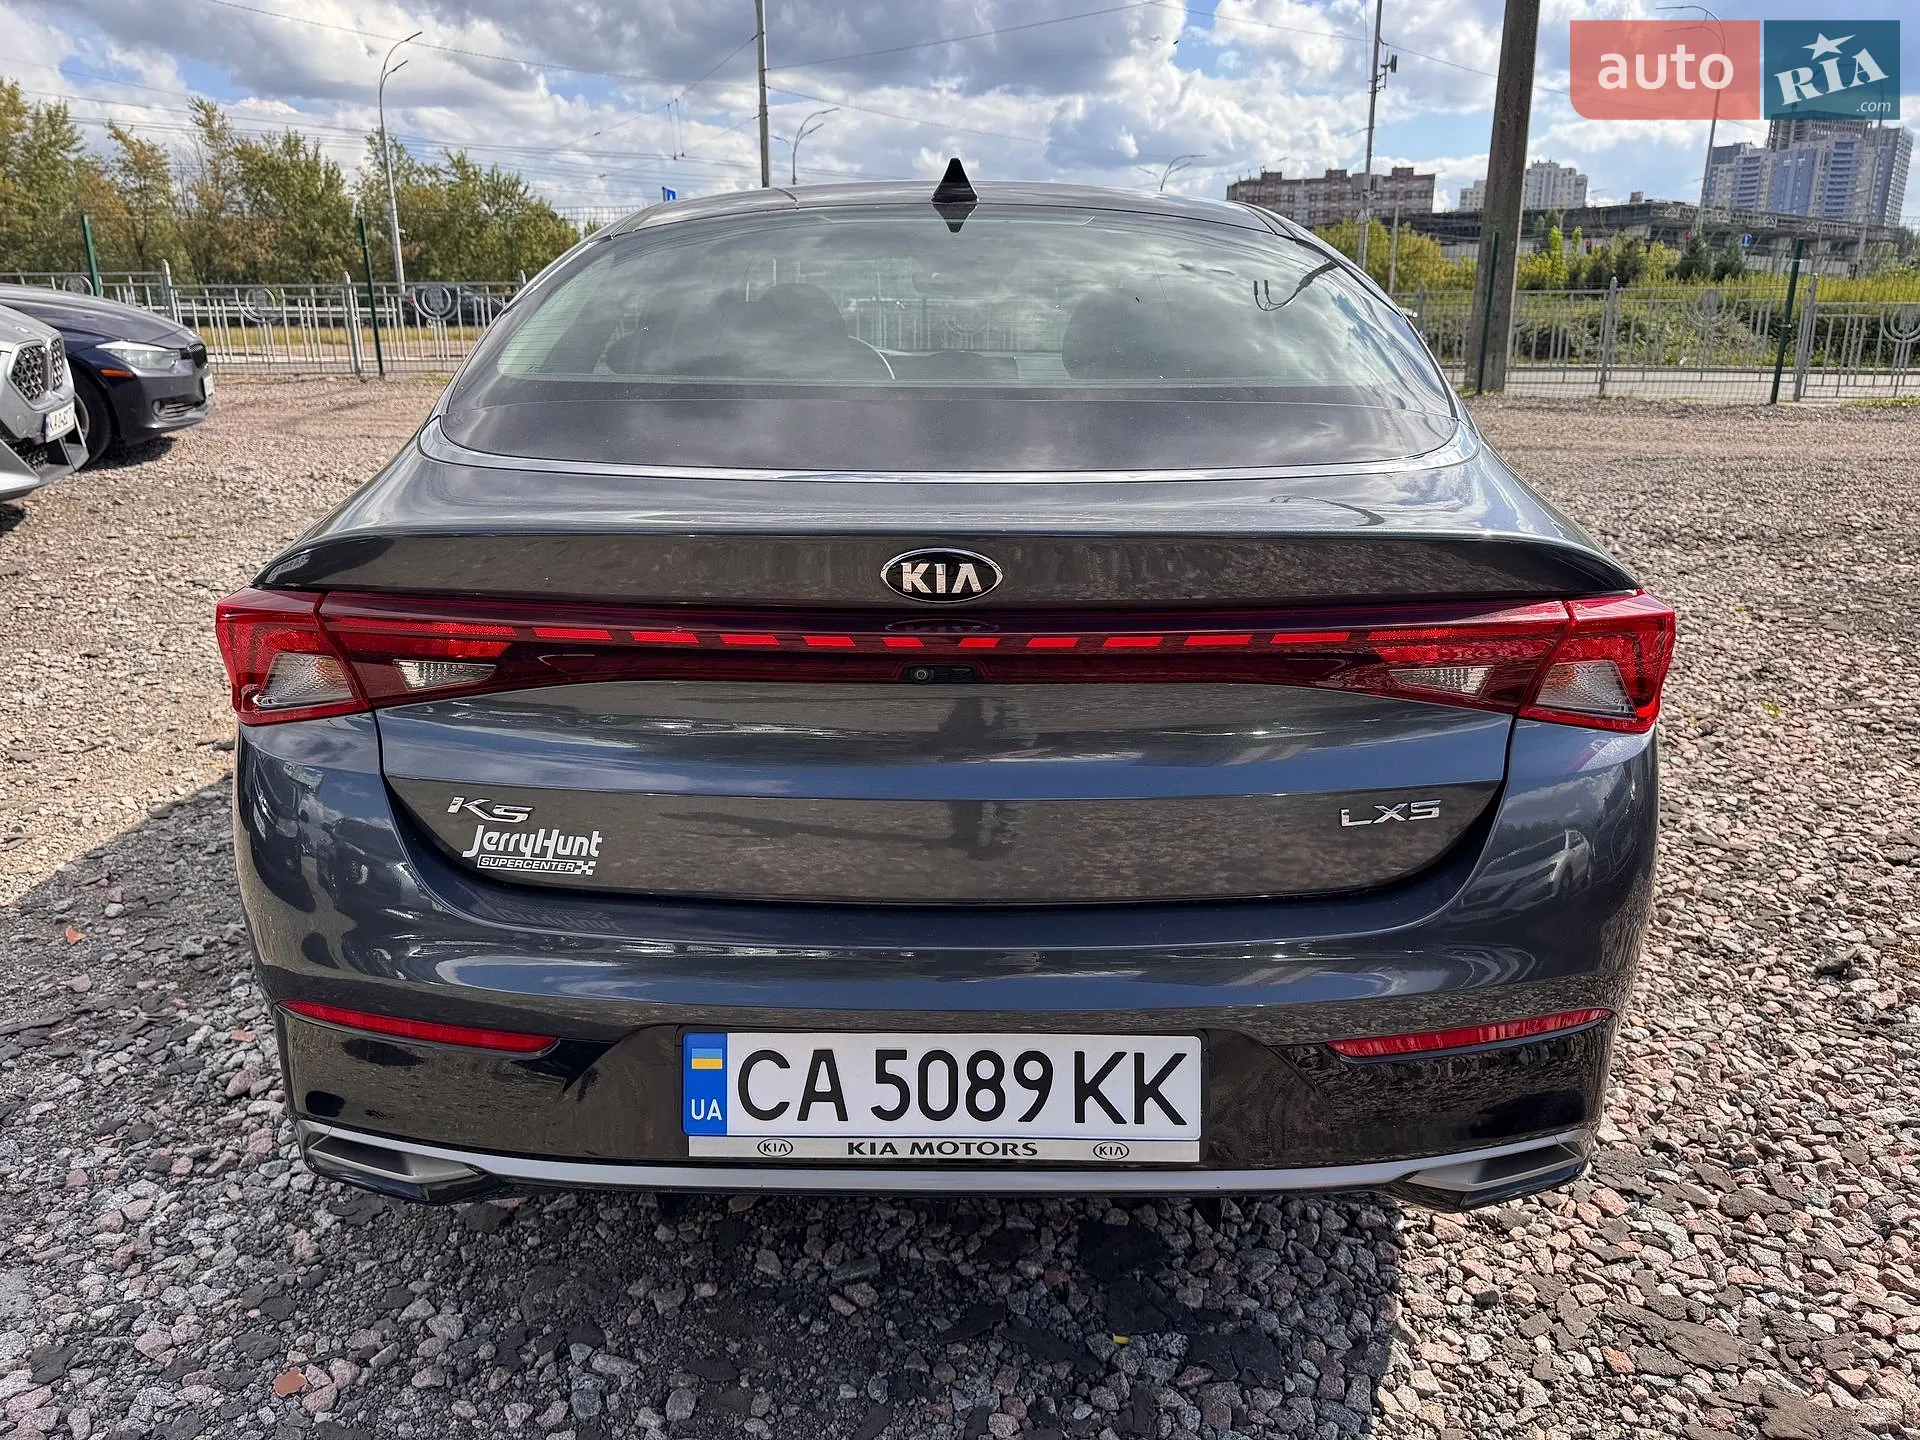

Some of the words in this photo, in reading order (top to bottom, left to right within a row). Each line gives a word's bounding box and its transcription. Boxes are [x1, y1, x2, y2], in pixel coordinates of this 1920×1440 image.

[901, 562, 983, 594] KIA
[1340, 800, 1442, 827] LXS
[480, 857, 576, 872] SUPERCENTER
[737, 1049, 849, 1122] CA
[870, 1049, 1054, 1124] 5089
[1074, 1050, 1188, 1126] KK
[691, 1099, 722, 1121] UA
[763, 1143, 788, 1153] KIA
[847, 1142, 899, 1156] KIA
[909, 1141, 1038, 1156] MOTORS
[1099, 1146, 1124, 1156] KIA
